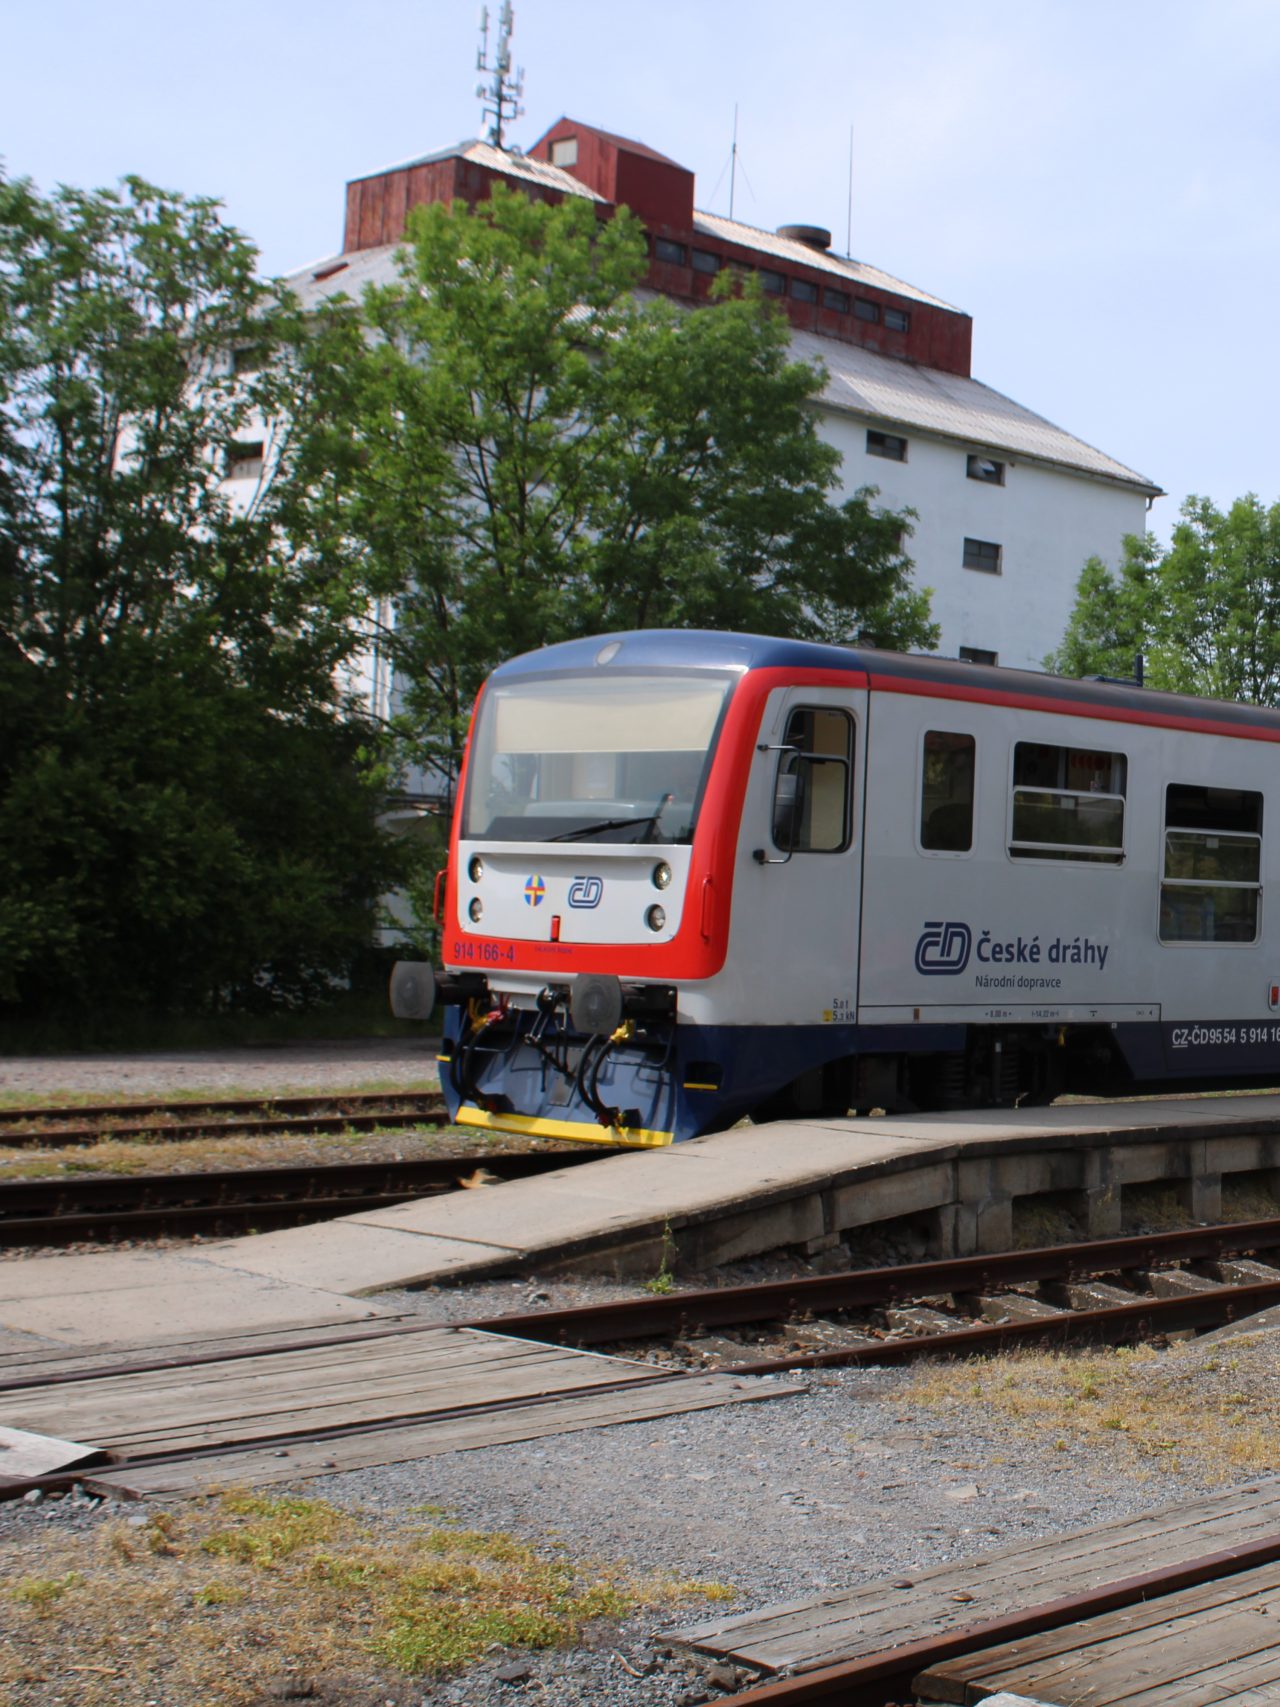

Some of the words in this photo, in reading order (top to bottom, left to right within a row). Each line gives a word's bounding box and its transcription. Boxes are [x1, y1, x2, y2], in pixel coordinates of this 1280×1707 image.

[454, 942, 474, 960] 914
[478, 943, 515, 962] 166-4
[976, 930, 1041, 963] České
[1048, 936, 1109, 970] dráhy
[975, 975, 1015, 988] Národní
[1017, 976, 1061, 990] dopravce
[1240, 1028, 1247, 1043] 5
[1249, 1027, 1268, 1043] 914
